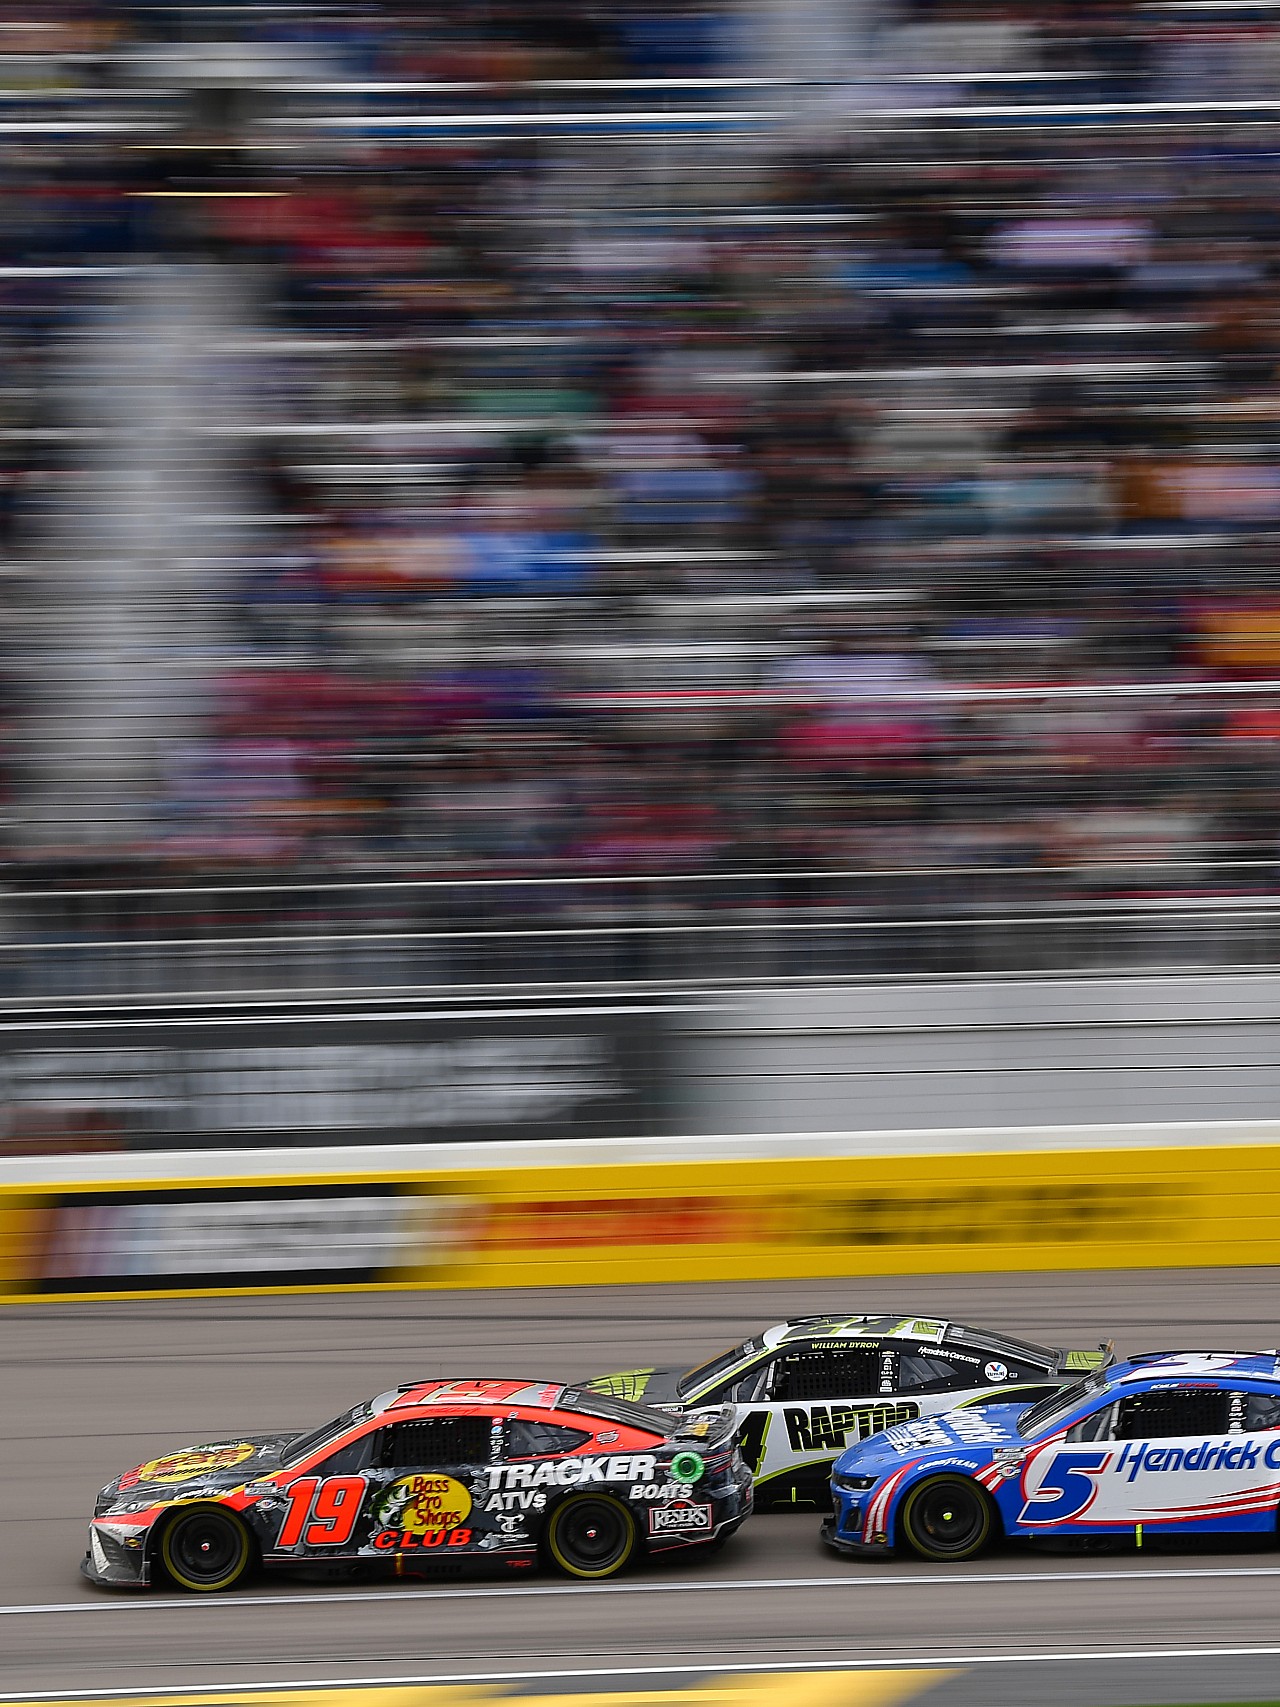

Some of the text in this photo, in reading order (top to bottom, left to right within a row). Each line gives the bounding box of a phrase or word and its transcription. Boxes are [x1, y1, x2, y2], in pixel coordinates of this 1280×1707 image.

[736, 1410, 773, 1477] 4
[484, 1455, 657, 1490] TRACKER
[411, 1476, 449, 1493] Bass
[629, 1484, 694, 1500] BOATS
[1016, 1450, 1115, 1527] 5
[413, 1493, 442, 1509] Pro
[484, 1491, 547, 1512] ATVs
[275, 1475, 369, 1549] 19
[414, 1509, 462, 1528] Shops
[374, 1528, 473, 1549] CLUB
